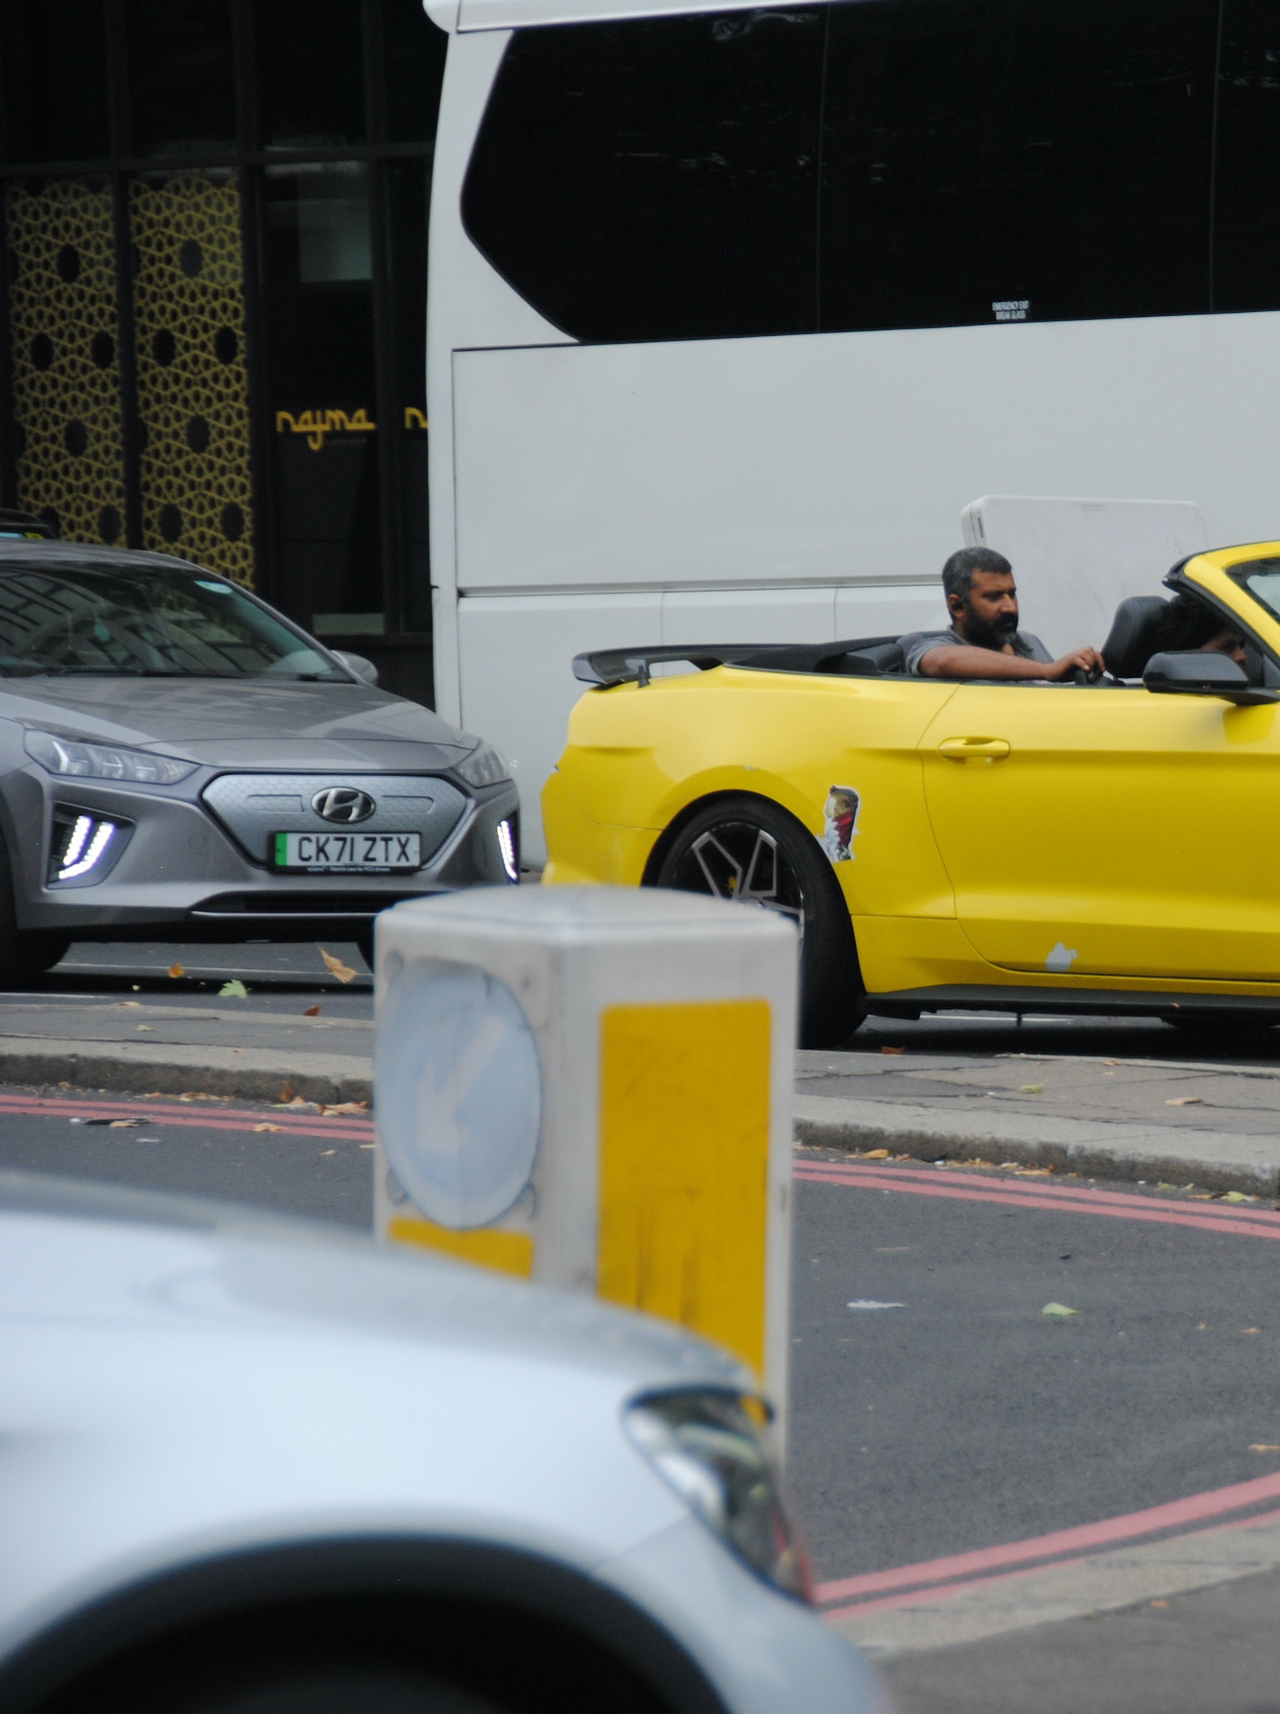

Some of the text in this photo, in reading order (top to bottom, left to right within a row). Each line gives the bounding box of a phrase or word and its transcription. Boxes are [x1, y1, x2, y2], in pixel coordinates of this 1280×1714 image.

[276, 408, 376, 450] najma
[297, 836, 410, 862] CK71 ZTX
